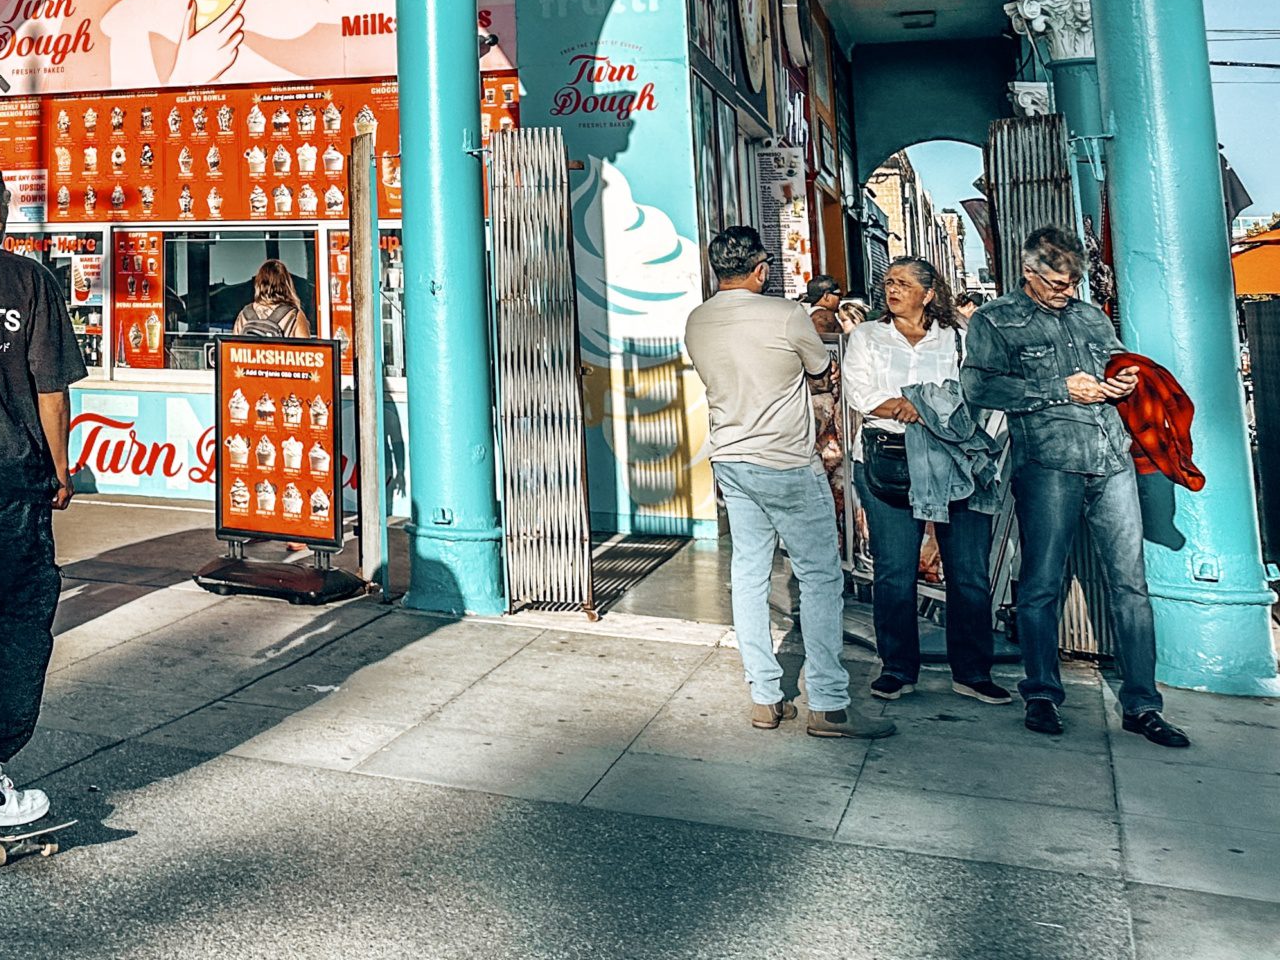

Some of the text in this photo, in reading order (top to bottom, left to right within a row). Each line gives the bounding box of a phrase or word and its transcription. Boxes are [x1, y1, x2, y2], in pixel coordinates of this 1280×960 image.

[11, 66, 65, 76] FRESHLY BAKED
[566, 54, 639, 85] Turn
[175, 94, 227, 103] GELATO BOWLS
[549, 82, 659, 121] Dough
[20, 183, 46, 191] UPSIDE
[3, 236, 96, 253] Order Here
[229, 347, 325, 368] MILKSHAKES
[69, 412, 184, 476] Turn
